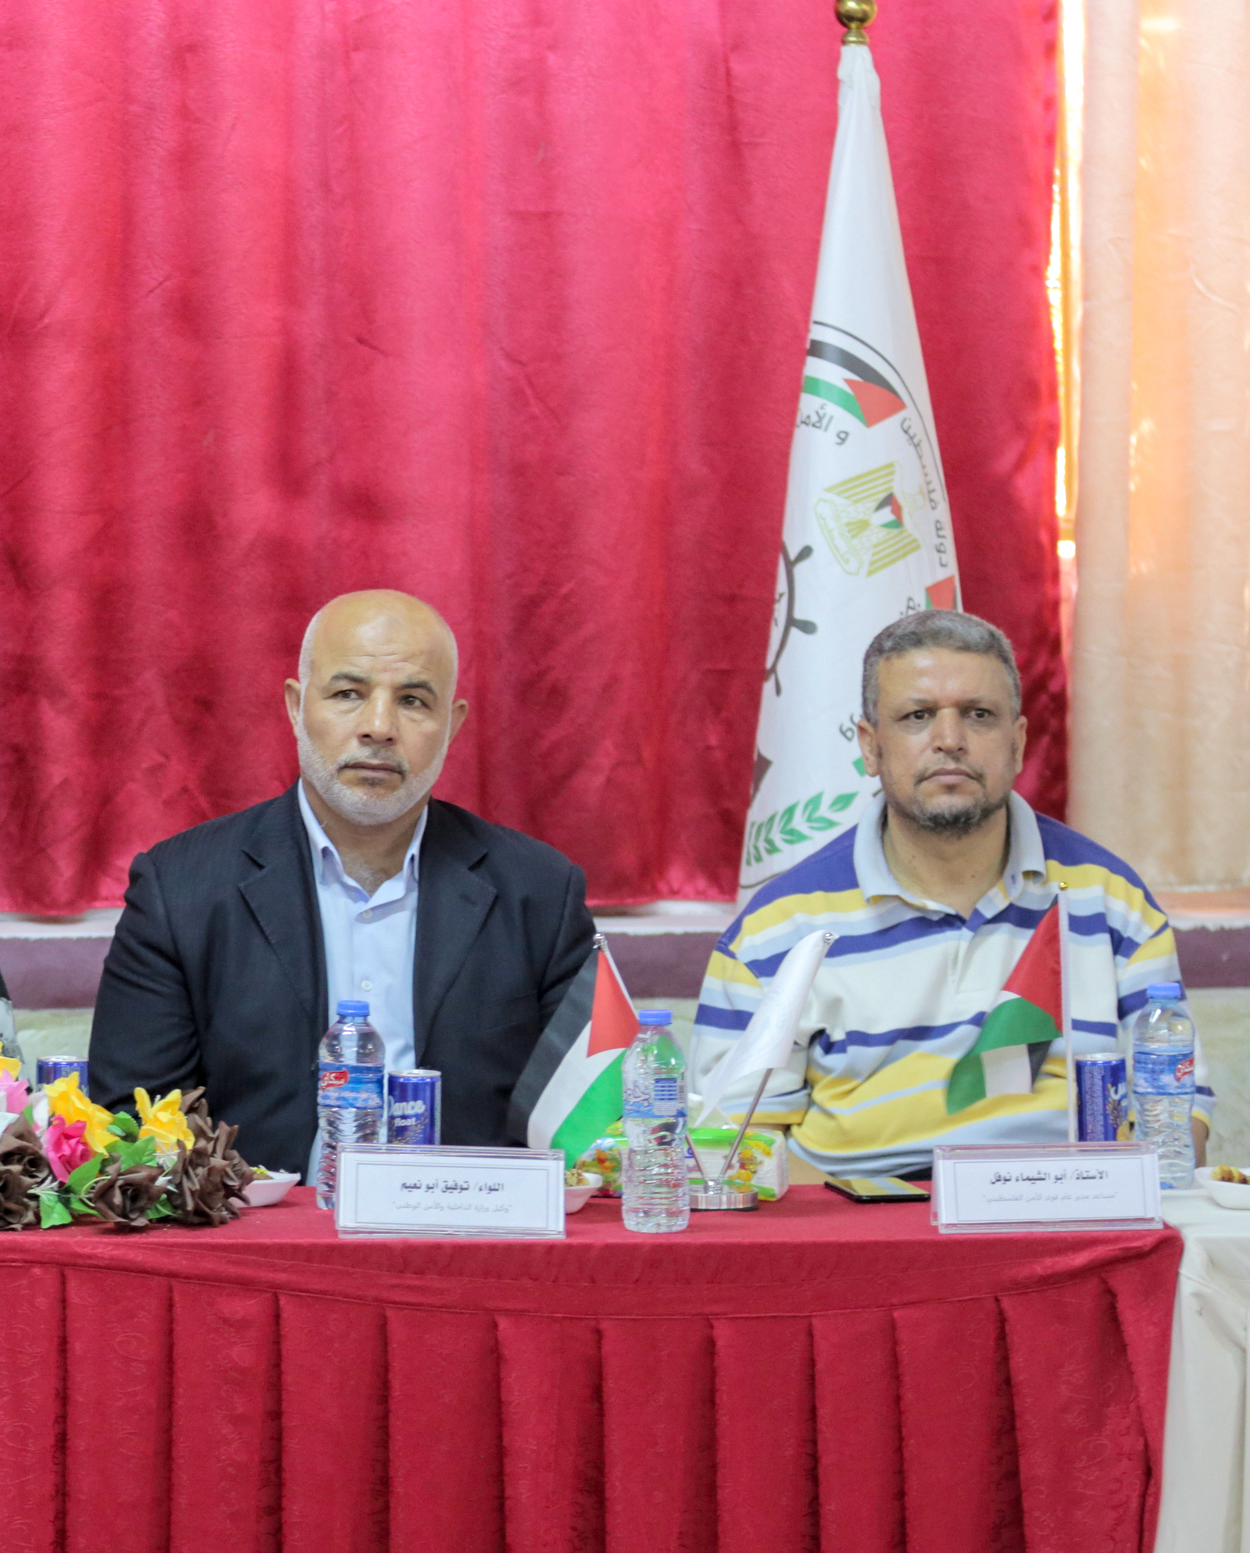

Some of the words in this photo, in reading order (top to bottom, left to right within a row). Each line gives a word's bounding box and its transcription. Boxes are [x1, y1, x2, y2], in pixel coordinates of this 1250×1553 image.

[1014, 1170, 1051, 1185] الشيماء
[1053, 1169, 1068, 1184] أبو
[400, 1179, 422, 1193] نعيم
[424, 1178, 439, 1194] أبو
[441, 1179, 470, 1194] توفيق
